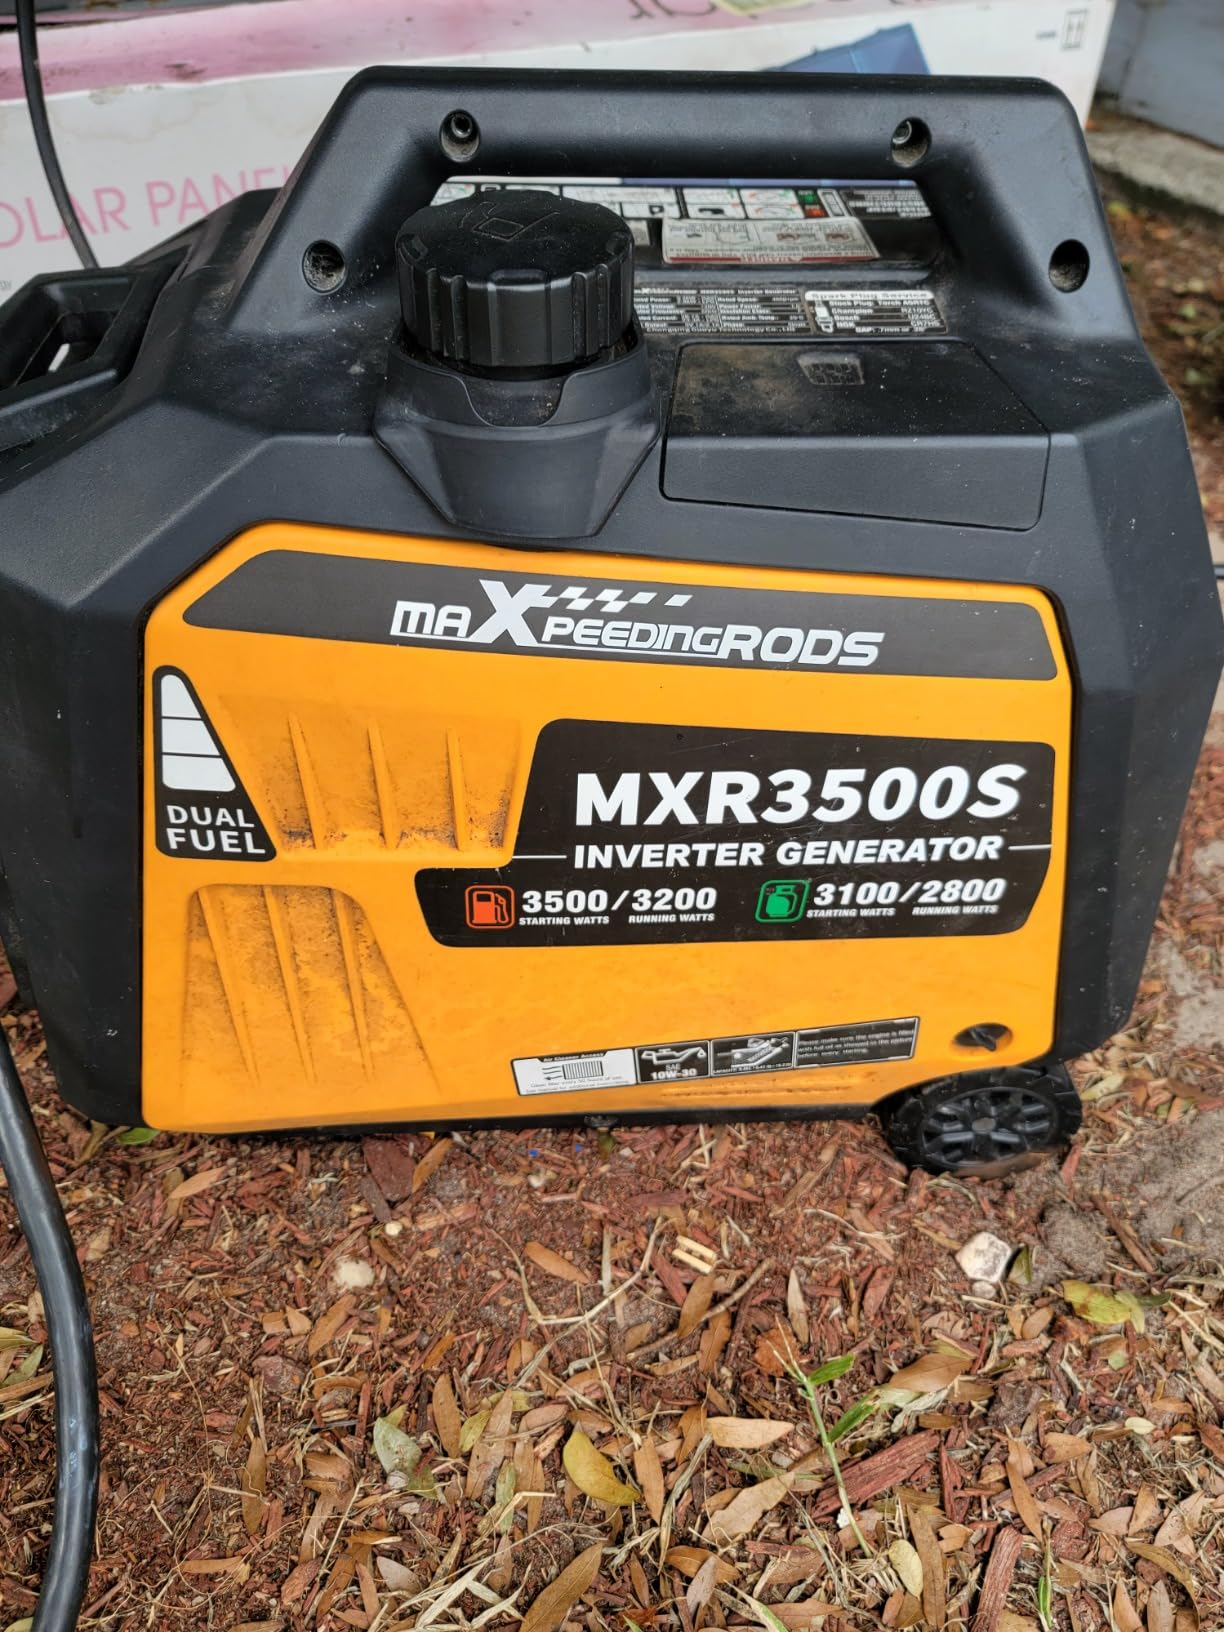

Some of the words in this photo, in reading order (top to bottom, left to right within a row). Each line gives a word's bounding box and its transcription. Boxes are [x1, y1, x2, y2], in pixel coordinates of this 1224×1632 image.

[575, 764, 1027, 827] MXR3500S
[166, 804, 255, 828] DUAL
[166, 827, 266, 854] FUEL
[573, 842, 765, 869] INVERTER
[776, 836, 1004, 866] GENERATOR
[521, 887, 718, 914] 3500/3200
[813, 878, 1007, 906] 3100/2800
[519, 916, 571, 926] STARTING
[573, 915, 610, 925] WATTS
[628, 914, 676, 924] RUNNING
[679, 913, 716, 922] WATTS
[806, 908, 857, 918] STARTING
[859, 907, 896, 917] WATTS
[911, 906, 960, 916] RUNNING
[962, 904, 999, 914] WATTS
[650, 1068, 698, 1080] 10W-30
